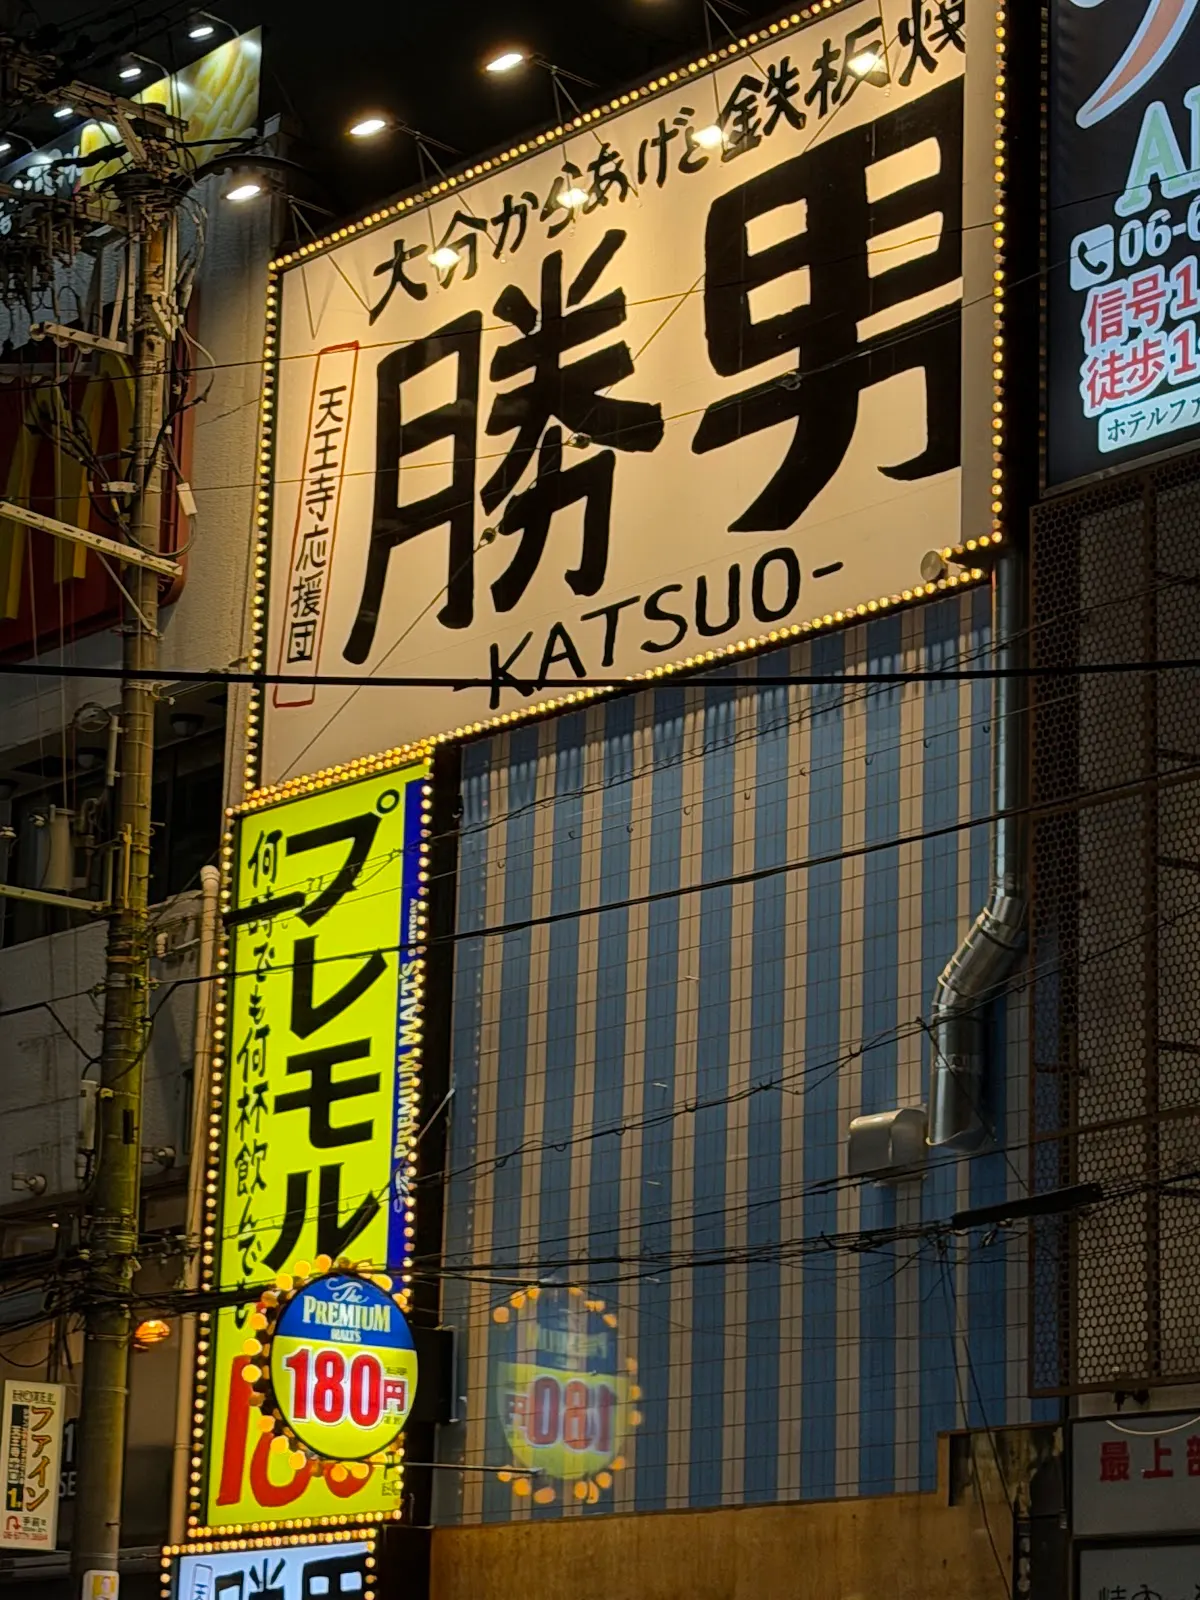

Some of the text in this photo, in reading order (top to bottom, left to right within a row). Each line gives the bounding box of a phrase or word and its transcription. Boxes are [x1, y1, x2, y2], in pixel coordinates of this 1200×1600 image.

[343, 73, 963, 664] 勝男
[286, 385, 347, 664] 天王寺応援団
[262, 788, 400, 1273] プレモル
[302, 1295, 391, 1333] PREMIUM
[325, 1277, 370, 1303] The
